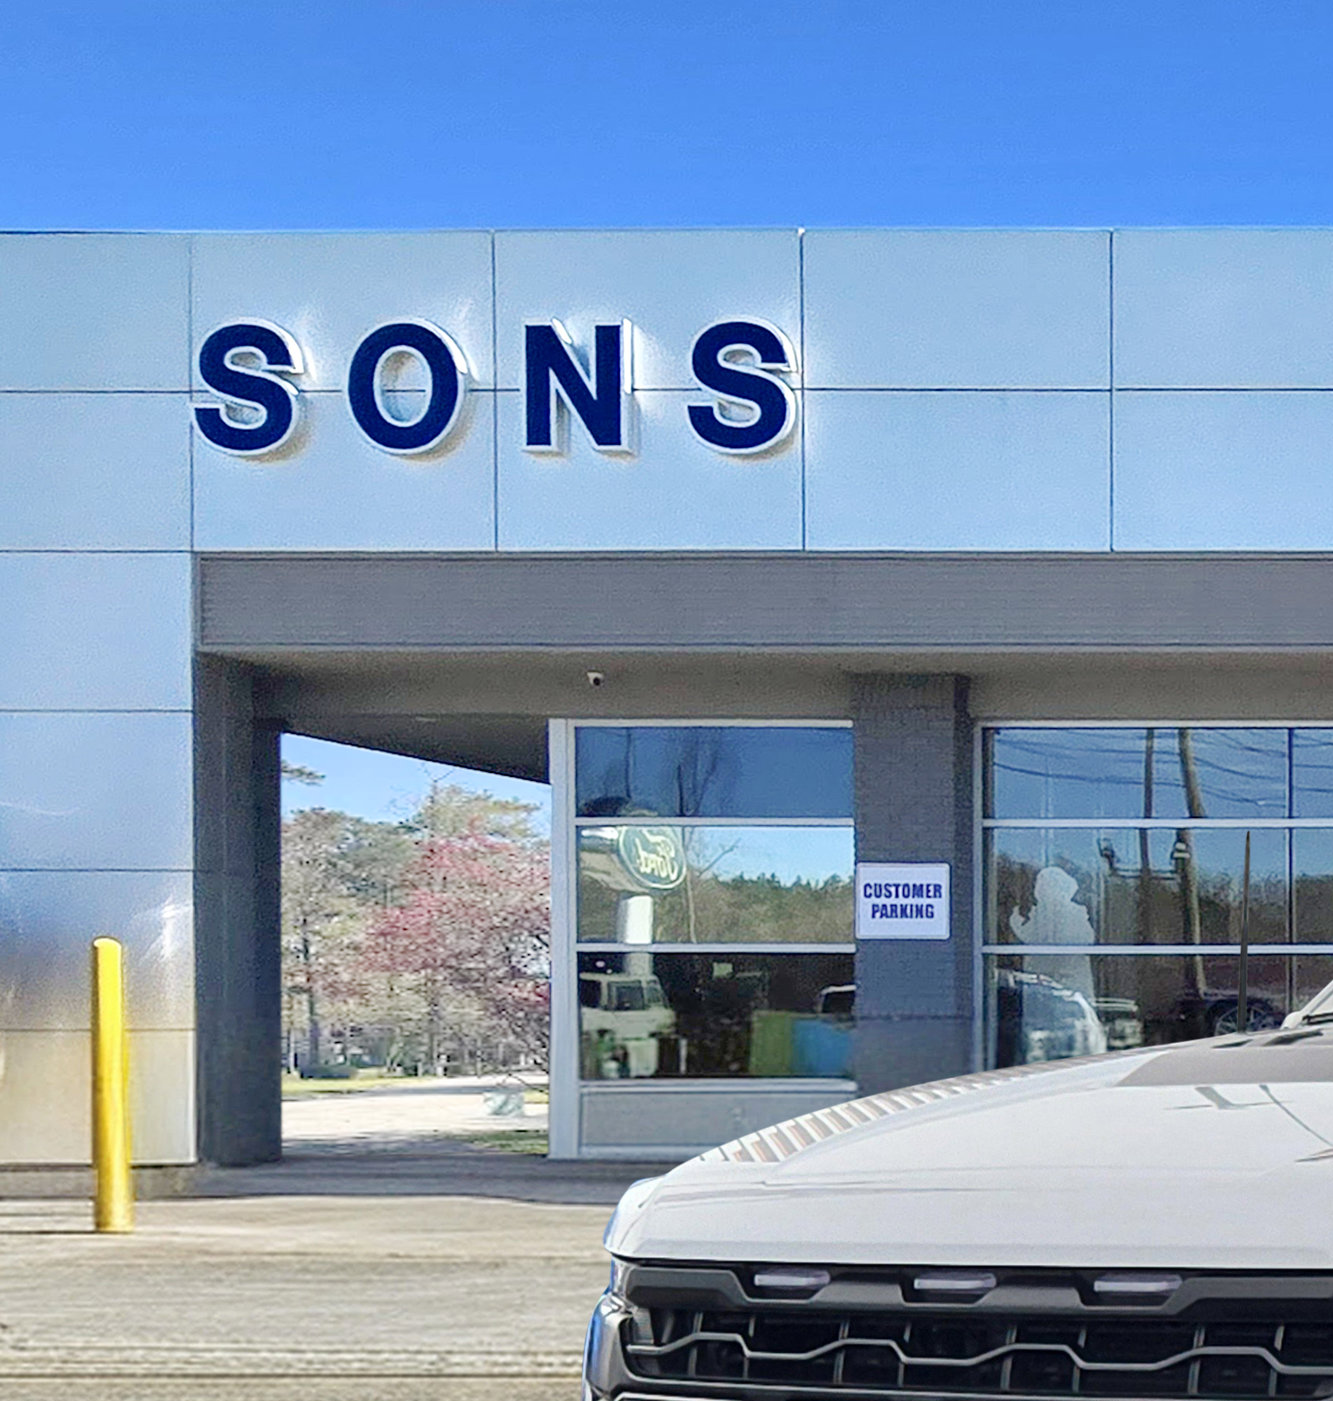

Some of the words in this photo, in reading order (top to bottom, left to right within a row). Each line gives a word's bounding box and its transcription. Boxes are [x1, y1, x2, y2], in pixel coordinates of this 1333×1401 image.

[192, 318, 800, 455] SONS
[863, 883, 942, 899] CUSTOMER
[871, 903, 935, 919] PARKING
